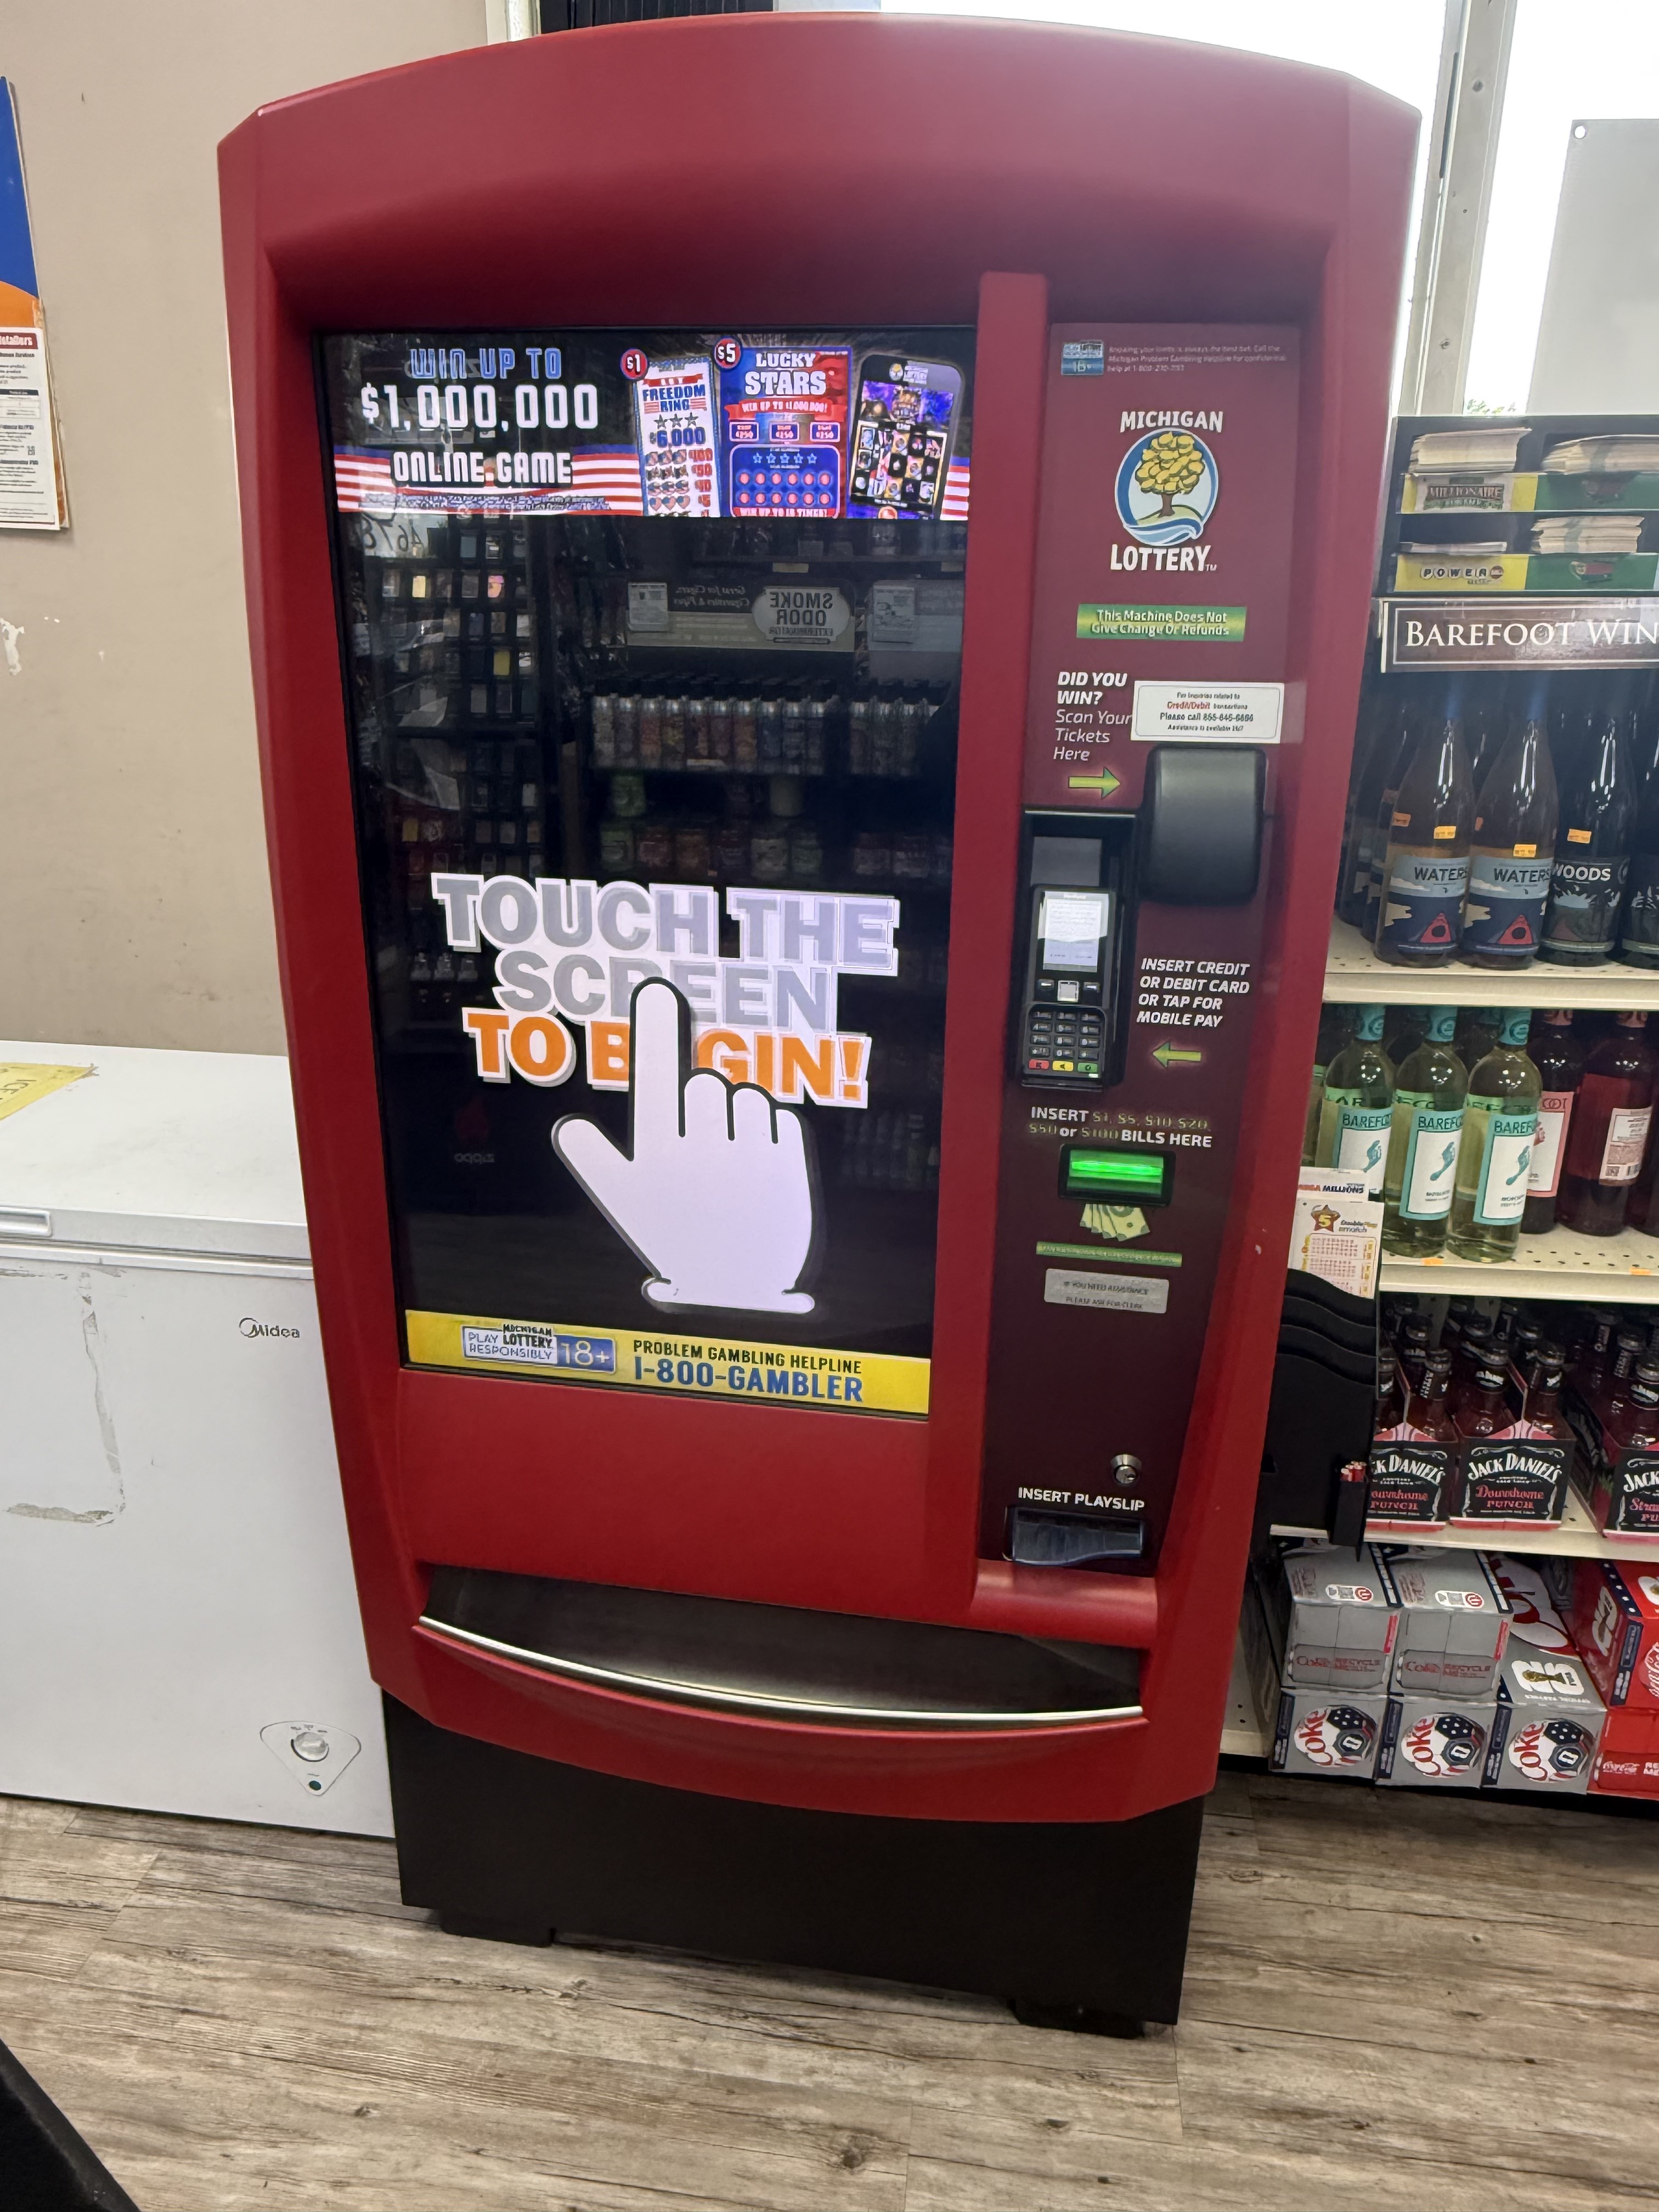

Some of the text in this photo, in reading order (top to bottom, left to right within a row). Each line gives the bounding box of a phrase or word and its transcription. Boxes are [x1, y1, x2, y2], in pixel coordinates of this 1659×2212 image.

[717, 343, 736, 363] $5
[755, 352, 816, 368] LUCKY
[410, 348, 561, 379] WIN UP TO
[627, 354, 641, 373] $1
[642, 384, 706, 402] FREEDOM
[744, 370, 827, 396] STARS
[361, 382, 599, 431] $1,000,000
[760, 401, 771, 411] UP
[1120, 410, 1224, 433] MICHIGAN
[393, 451, 572, 484] ONLINE GAME
[1110, 543, 1211, 572] LOTTERY
[1096, 609, 1228, 623] This Machine Does Not
[1091, 622, 1230, 637] Give Change Or Refunds
[1404, 620, 1576, 647] BAREFOOT
[1057, 670, 1128, 687] DID YOU
[1057, 690, 1103, 706] WIN?
[1055, 709, 1132, 725] Scan Your
[1160, 712, 1186, 721] Please
[1187, 713, 1201, 721] call
[1056, 727, 1111, 743] Tickets
[1053, 747, 1090, 761] Here
[433, 874, 897, 968] TOUCH THE
[1141, 957, 1250, 976] INSERT CREDIT
[1139, 975, 1250, 994] OR DEBIT CARD
[1138, 994, 1223, 1010] OR TAP FOR
[1136, 1011, 1223, 1028] MOBILE PAY
[464, 1009, 868, 1105] TO BGIN!
[1031, 1106, 1089, 1122] INSERT
[1059, 1127, 1078, 1138] or
[1121, 1129, 1165, 1144] BILLS
[1169, 1133, 1213, 1148] HERE
[1318, 1214, 1331, 1227] 5
[239, 1317, 301, 1339] Midea
[469, 1342, 552, 1360] RESPONSIBLY
[503, 1334, 554, 1349] LOTTERY
[560, 1340, 610, 1365] 18+
[634, 1339, 862, 1374] PROBLEM GAMBLING HELPLINE
[635, 1356, 863, 1402] 1-800-GAMBLER
[1388, 1454, 1446, 1486] DANIEL'S
[1468, 1453, 1562, 1485] JACK DANIEL'S
[1623, 1471, 1659, 1492] JACK
[1018, 1487, 1145, 1511] INSERT PLAYSLIP
[1372, 1489, 1429, 1501] ownhome
[1298, 1707, 1334, 1766] Coke
[1406, 1716, 1441, 1776] Coke
[1513, 1721, 1548, 1781] Coke
